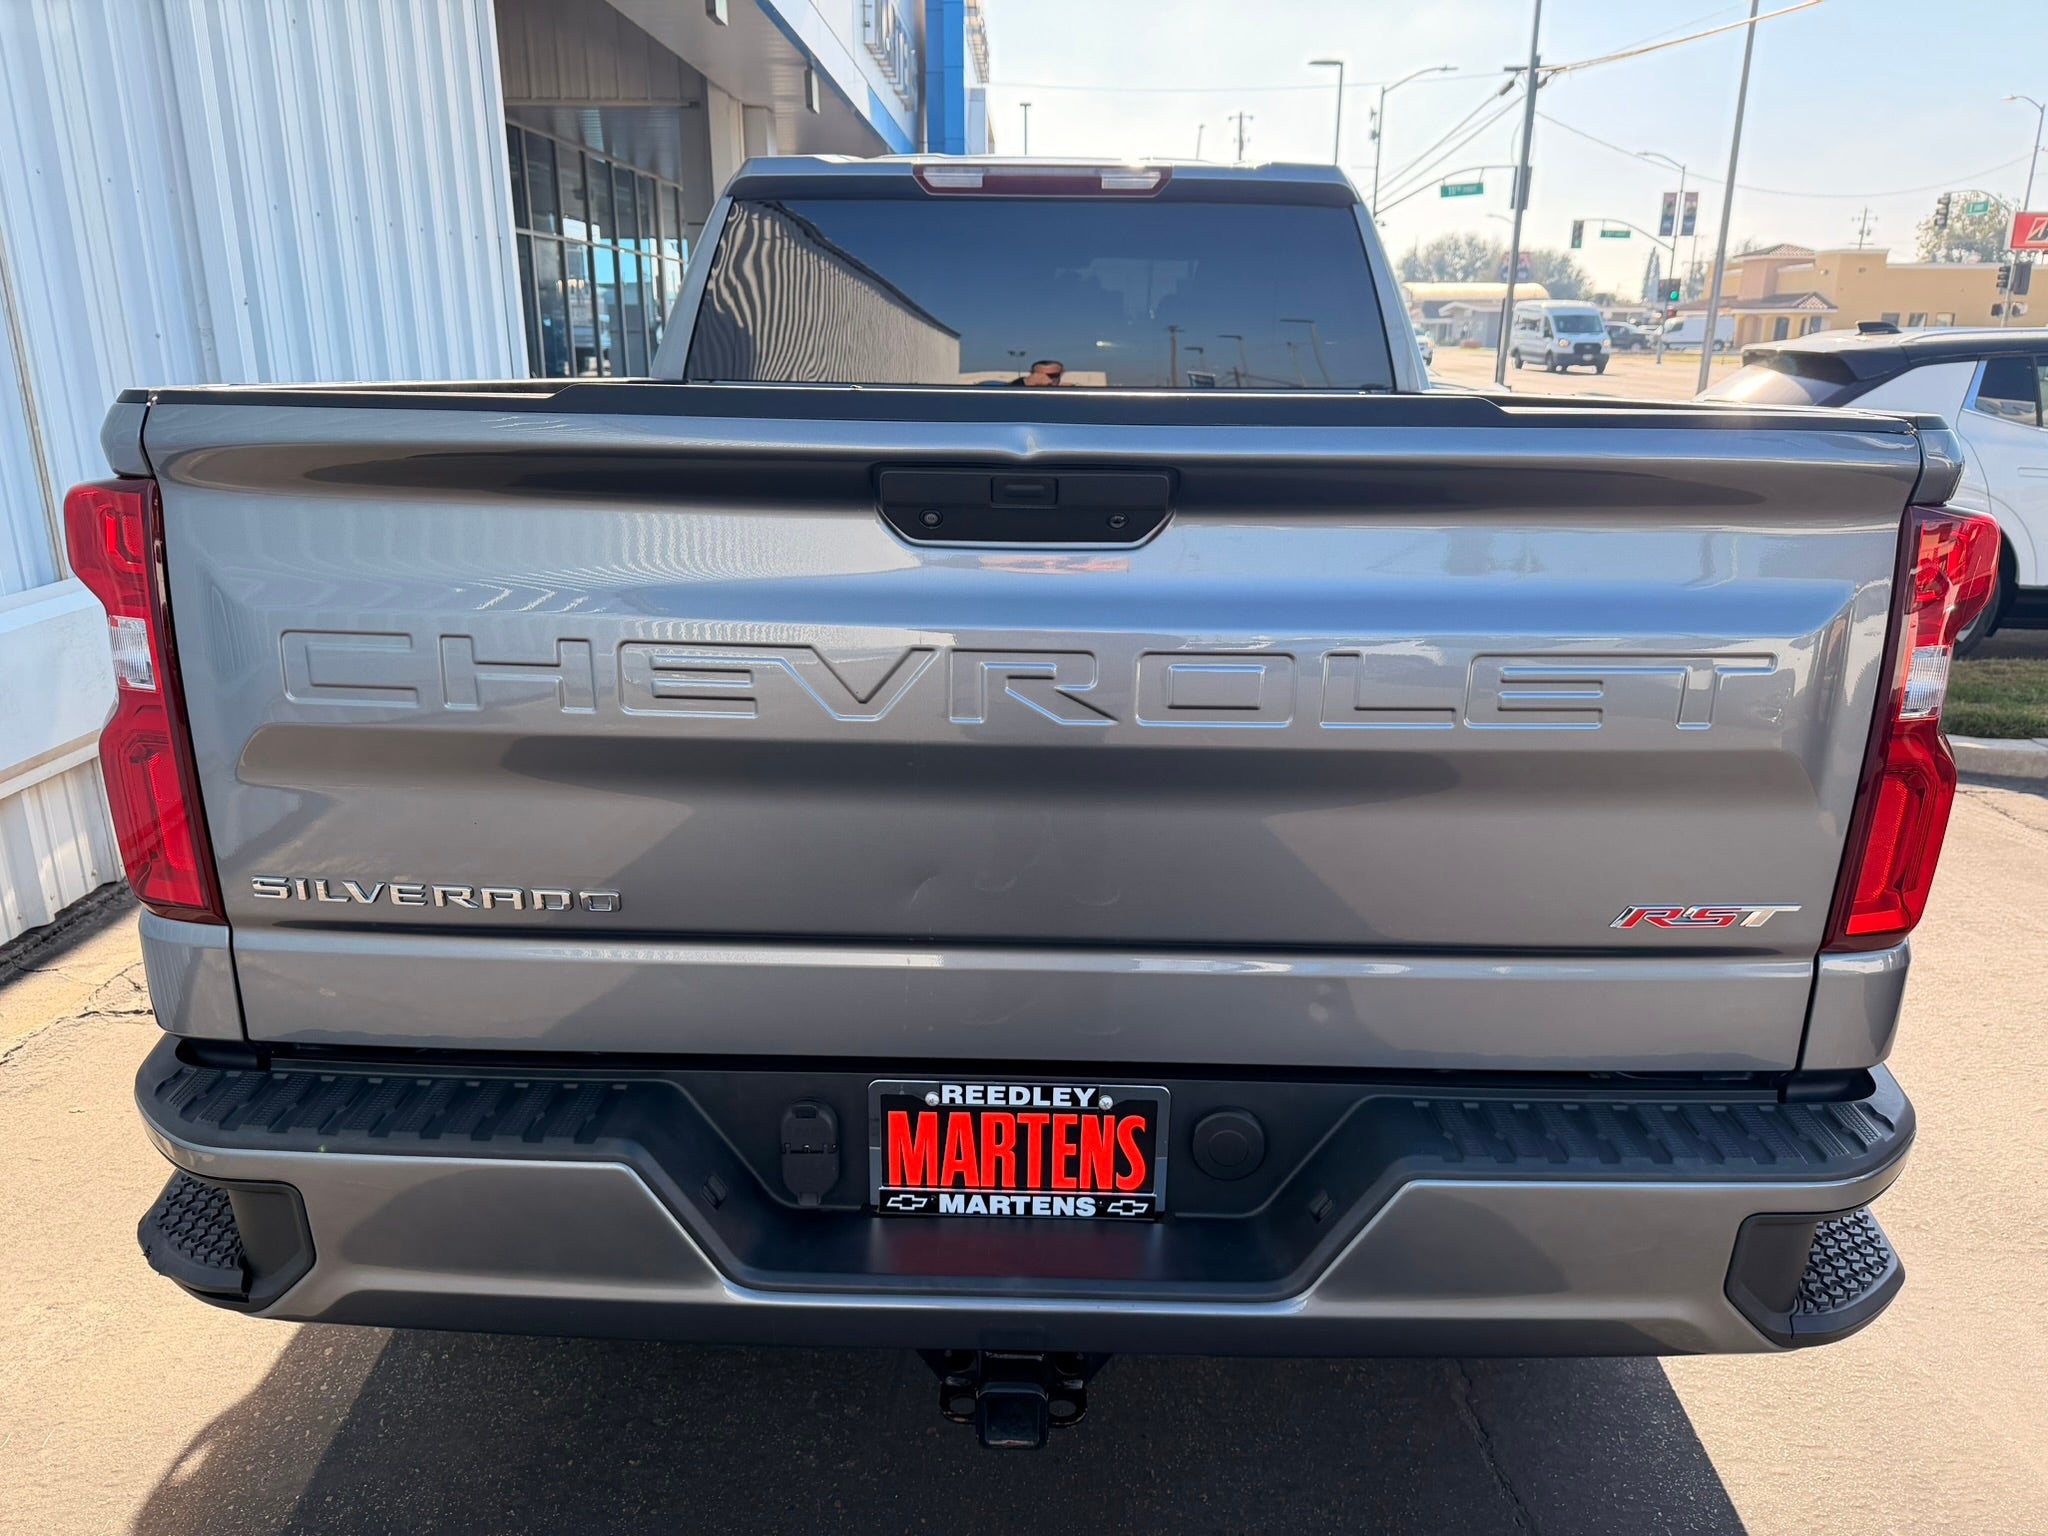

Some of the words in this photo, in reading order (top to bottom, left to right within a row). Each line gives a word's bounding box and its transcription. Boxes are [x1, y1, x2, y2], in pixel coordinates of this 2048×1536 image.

[280, 629, 1778, 731] CHEVROLET
[250, 875, 622, 914] SILVERADO
[1608, 903, 1802, 930] RST
[941, 1084, 1097, 1108] REEDLEY
[887, 1110, 1147, 1191] MARTENS
[938, 1193, 1097, 1217] MARTENS
